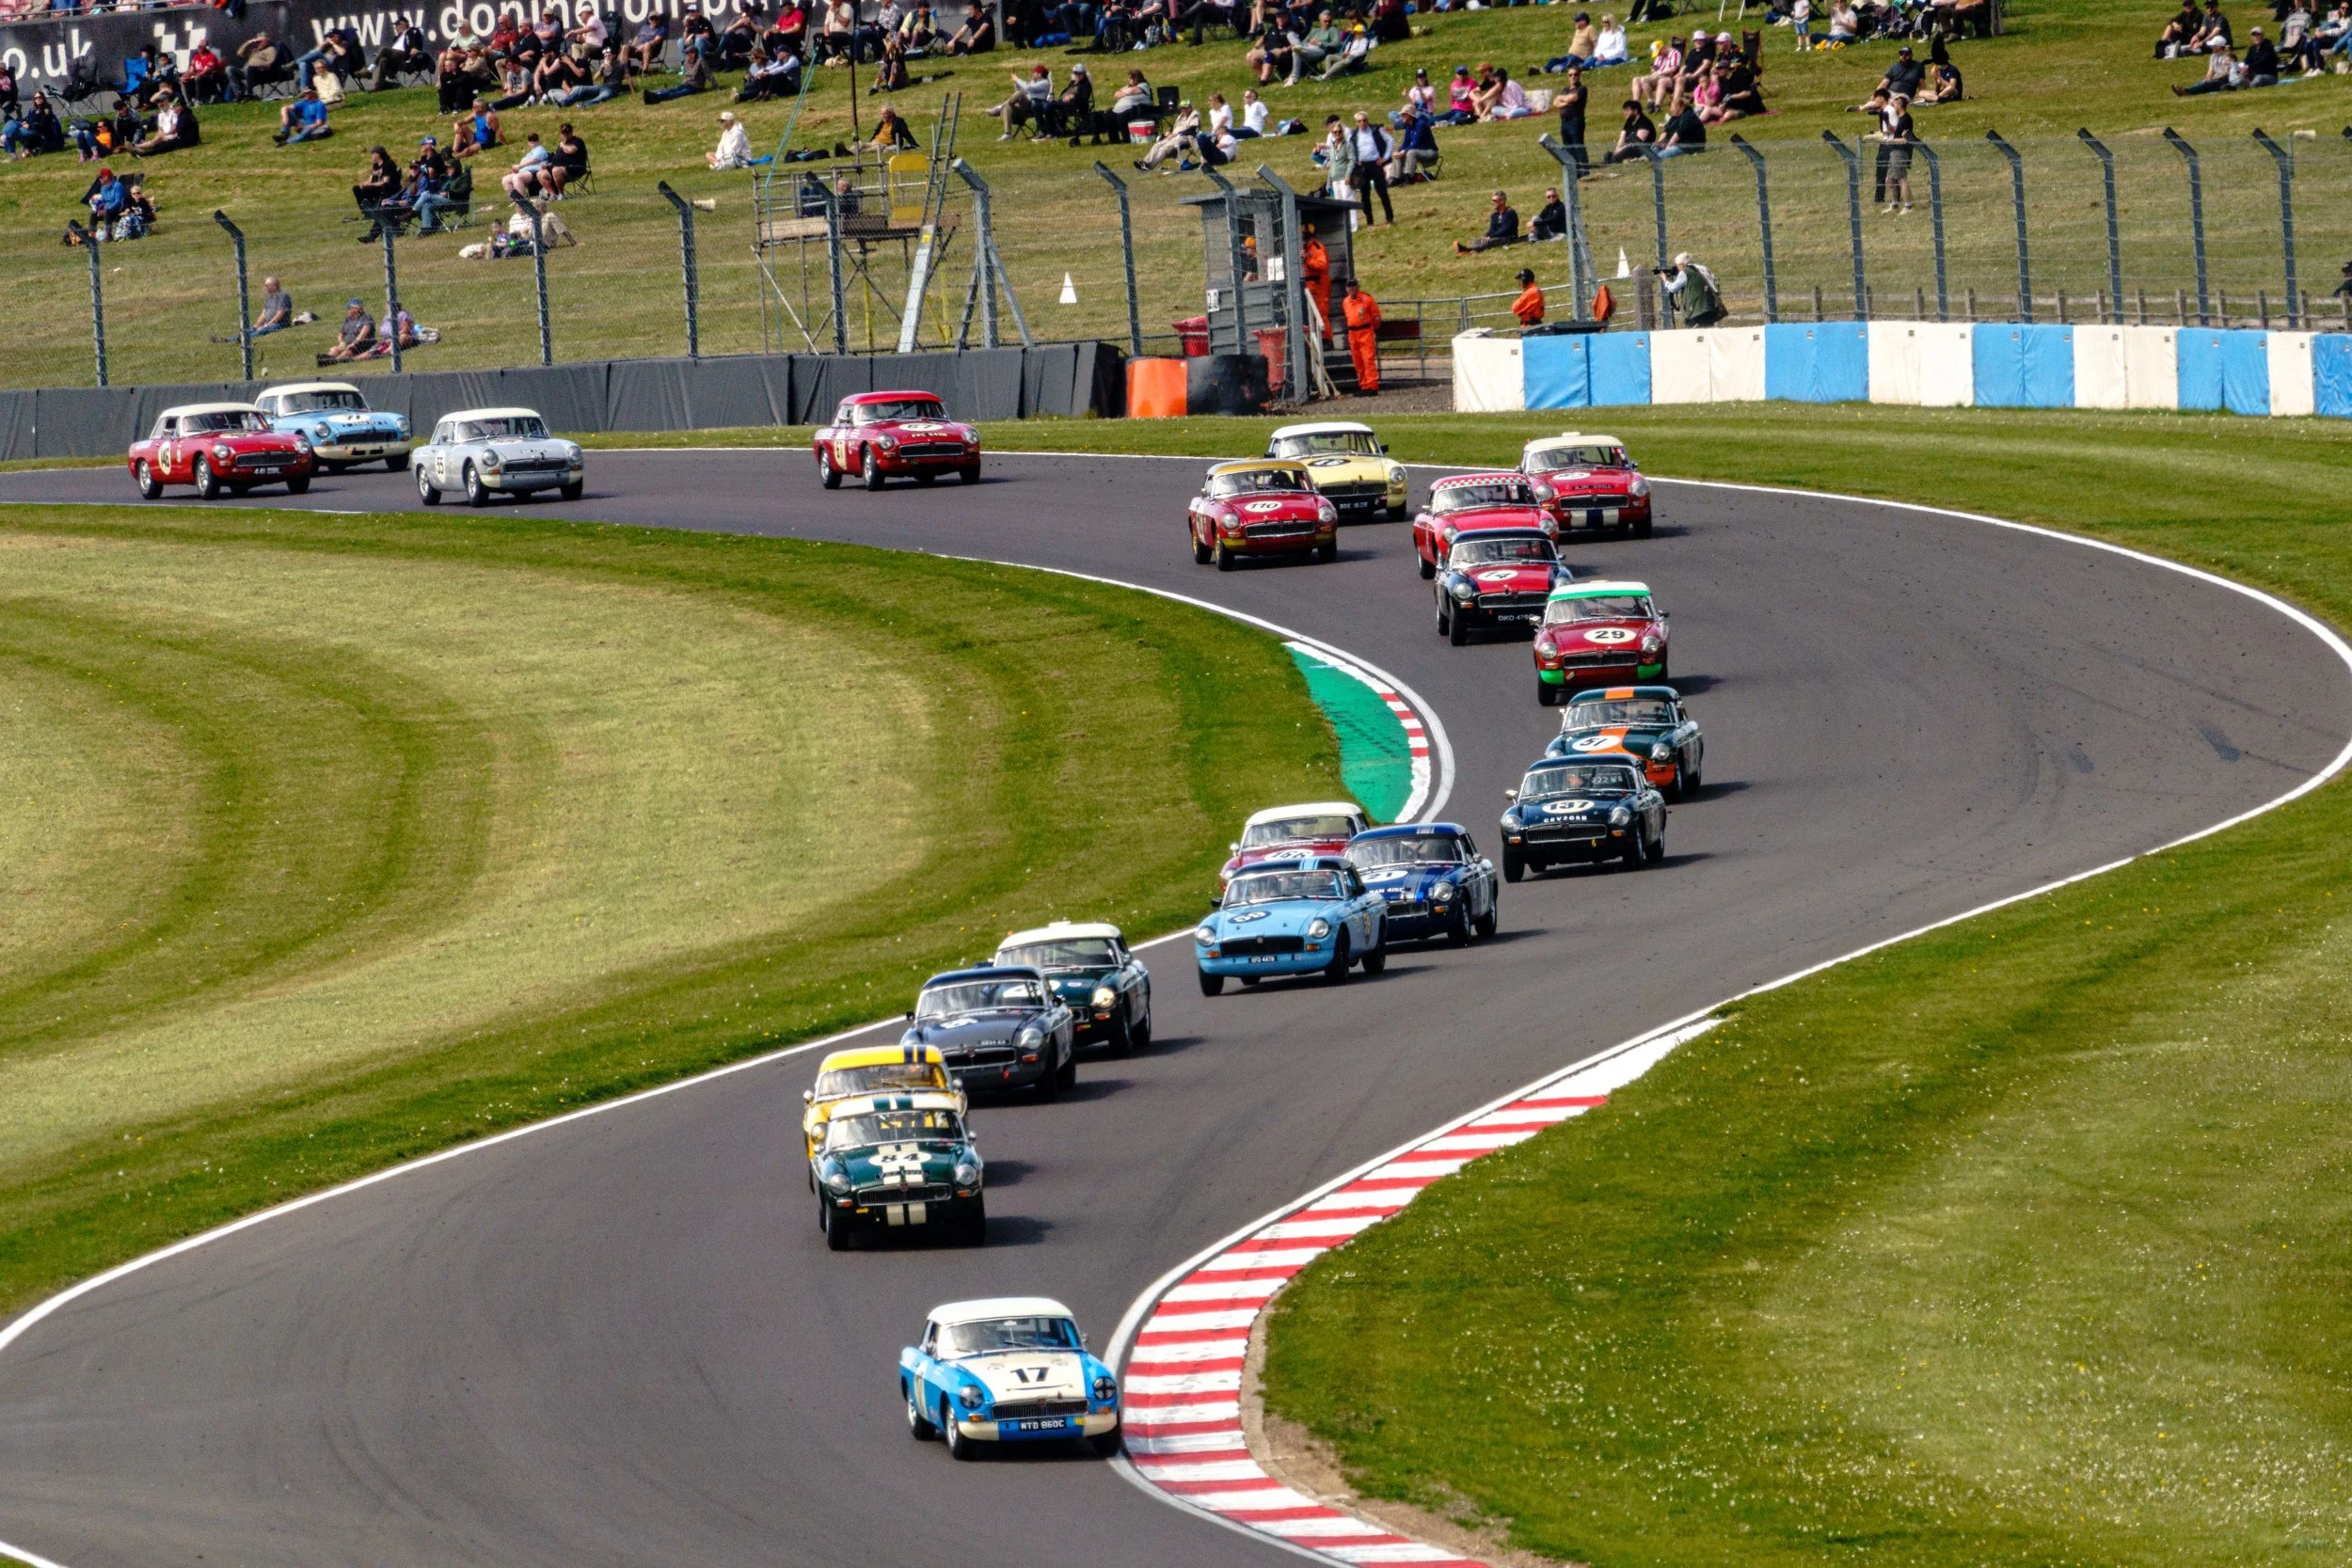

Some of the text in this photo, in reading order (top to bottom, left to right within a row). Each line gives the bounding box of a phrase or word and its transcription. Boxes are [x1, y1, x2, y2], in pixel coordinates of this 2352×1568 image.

[1595, 629, 1625, 640] 29
[1580, 737, 1608, 747] 51
[1547, 801, 1591, 810] 137
[881, 1153, 919, 1163] 84
[1009, 1367, 1050, 1384] 17
